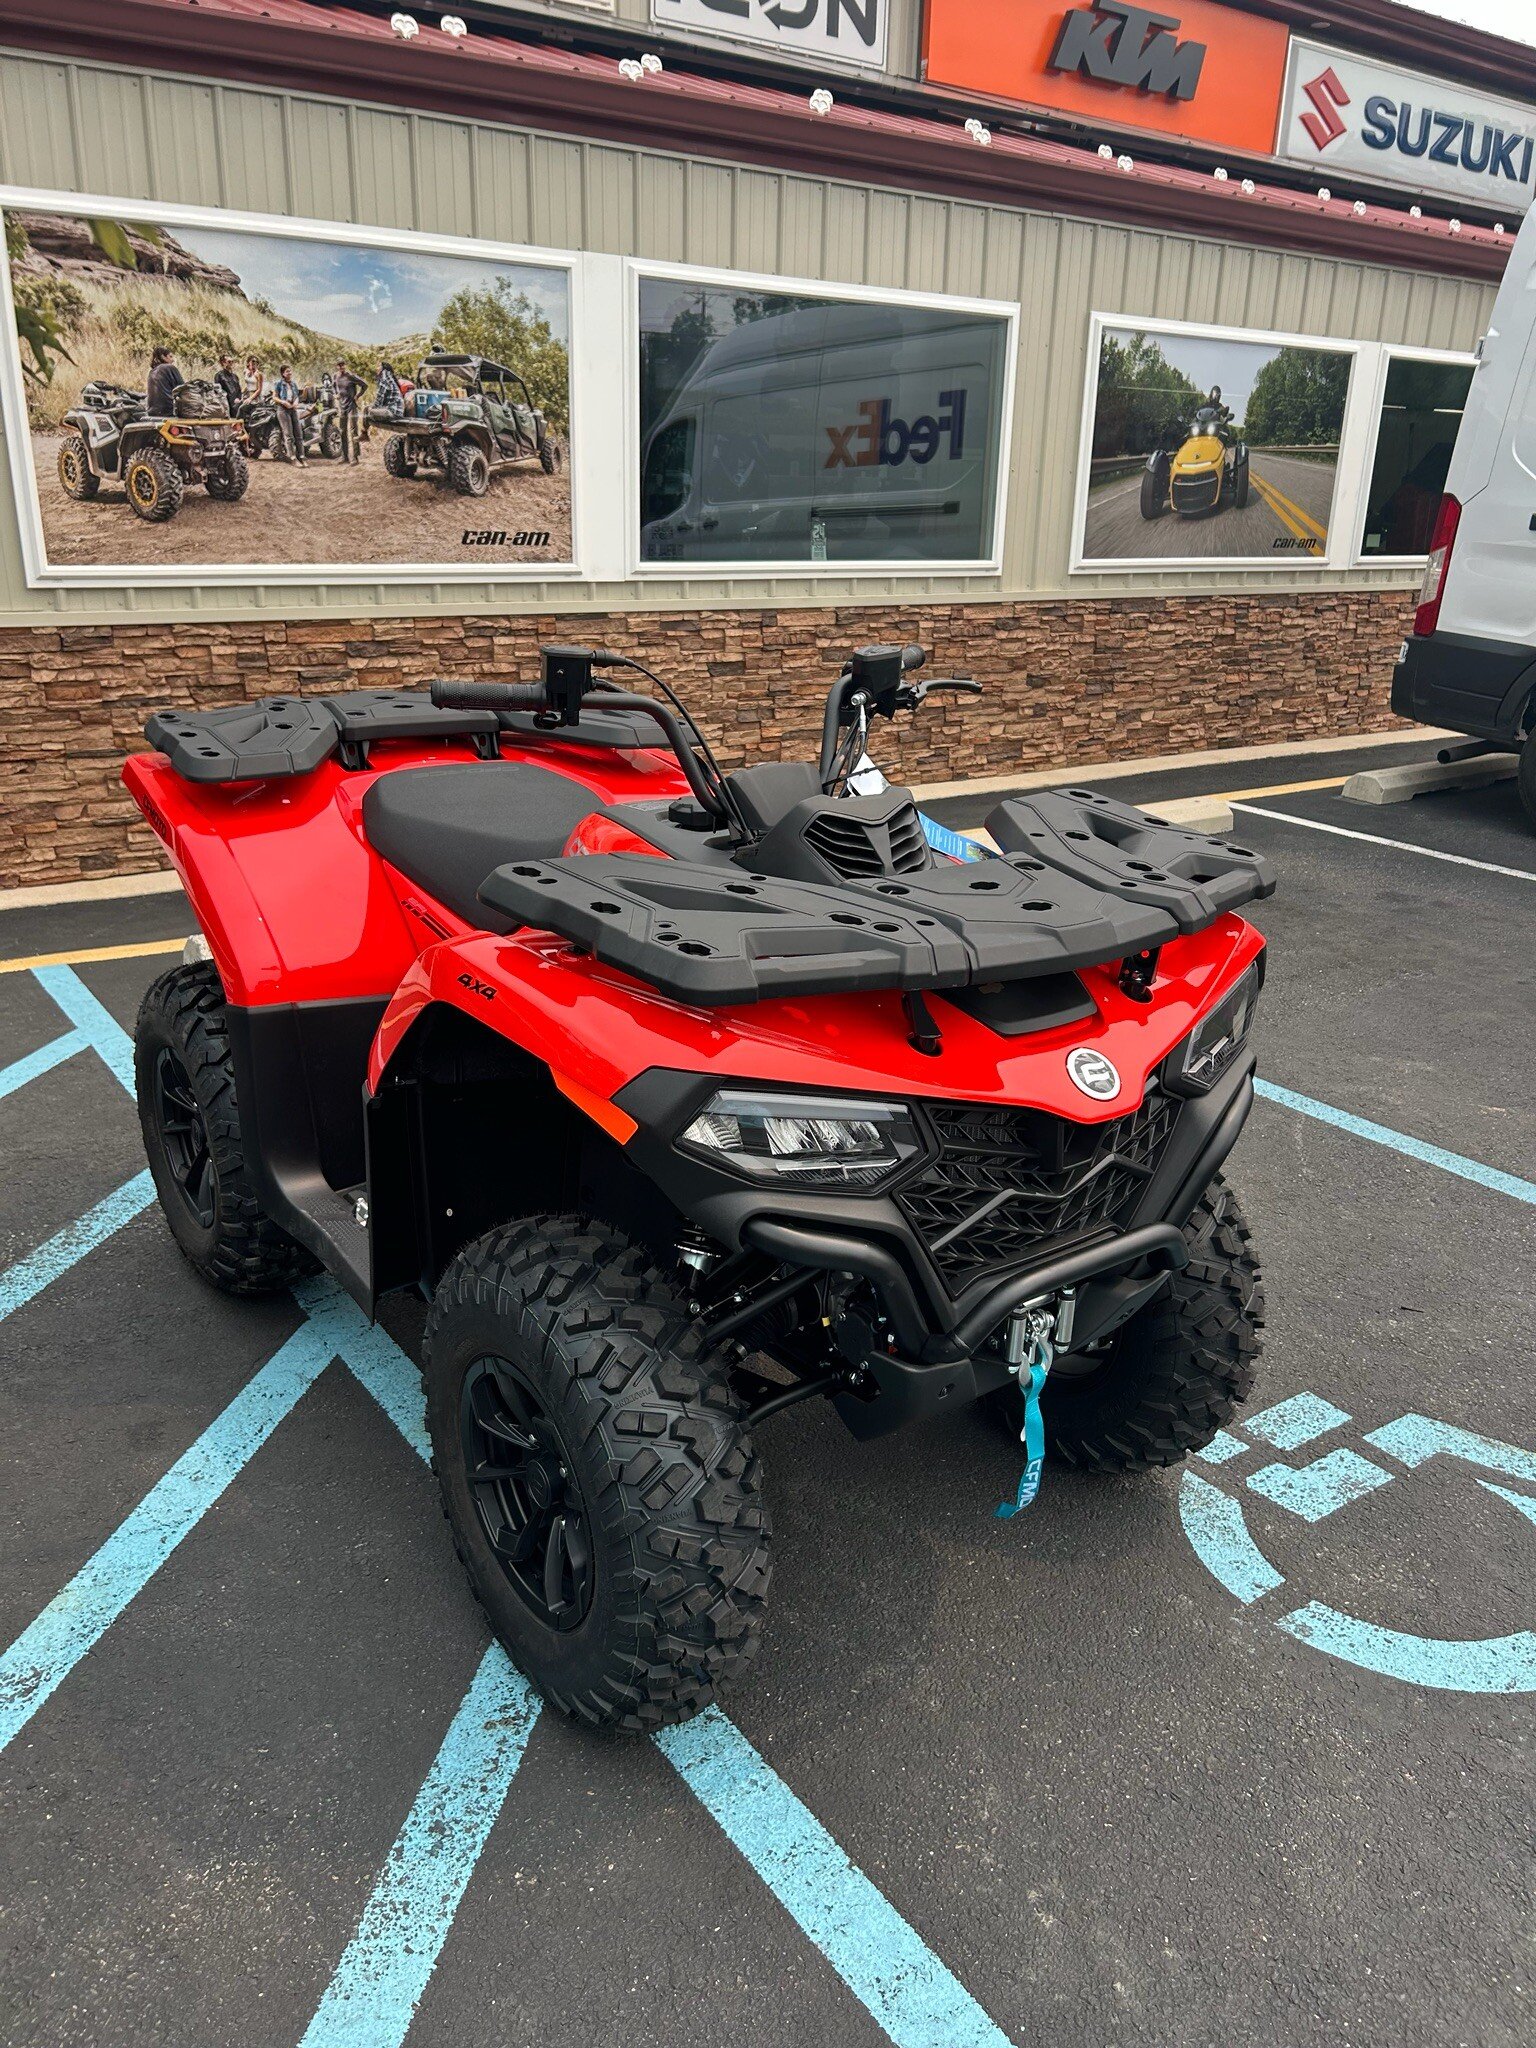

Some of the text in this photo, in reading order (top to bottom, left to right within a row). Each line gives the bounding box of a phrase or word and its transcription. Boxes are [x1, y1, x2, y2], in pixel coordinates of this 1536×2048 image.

[1047, 0, 1208, 101] KTM
[1361, 95, 1535, 185] SUZUKI
[461, 530, 550, 546] can-am
